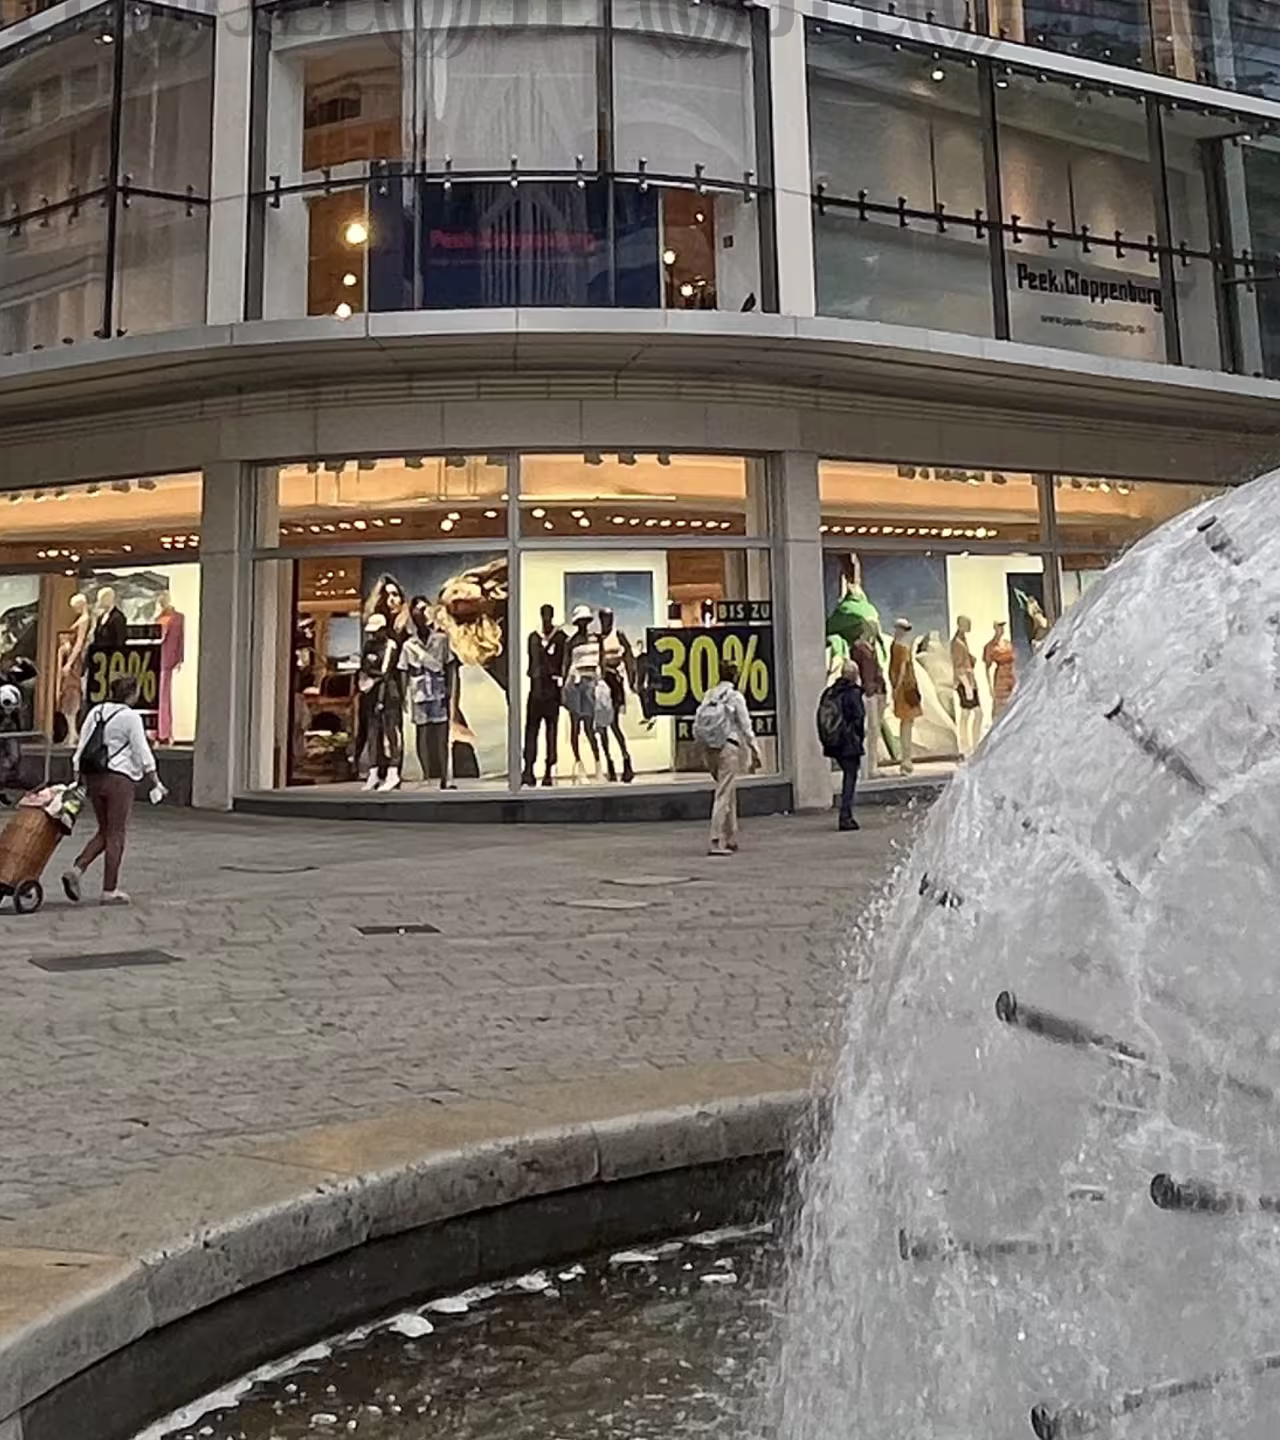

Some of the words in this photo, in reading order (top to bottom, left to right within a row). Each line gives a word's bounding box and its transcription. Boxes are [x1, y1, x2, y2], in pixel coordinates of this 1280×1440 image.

[720, 603, 745, 619] BIS
[751, 603, 770, 619] ZU
[654, 634, 769, 706] 30%
